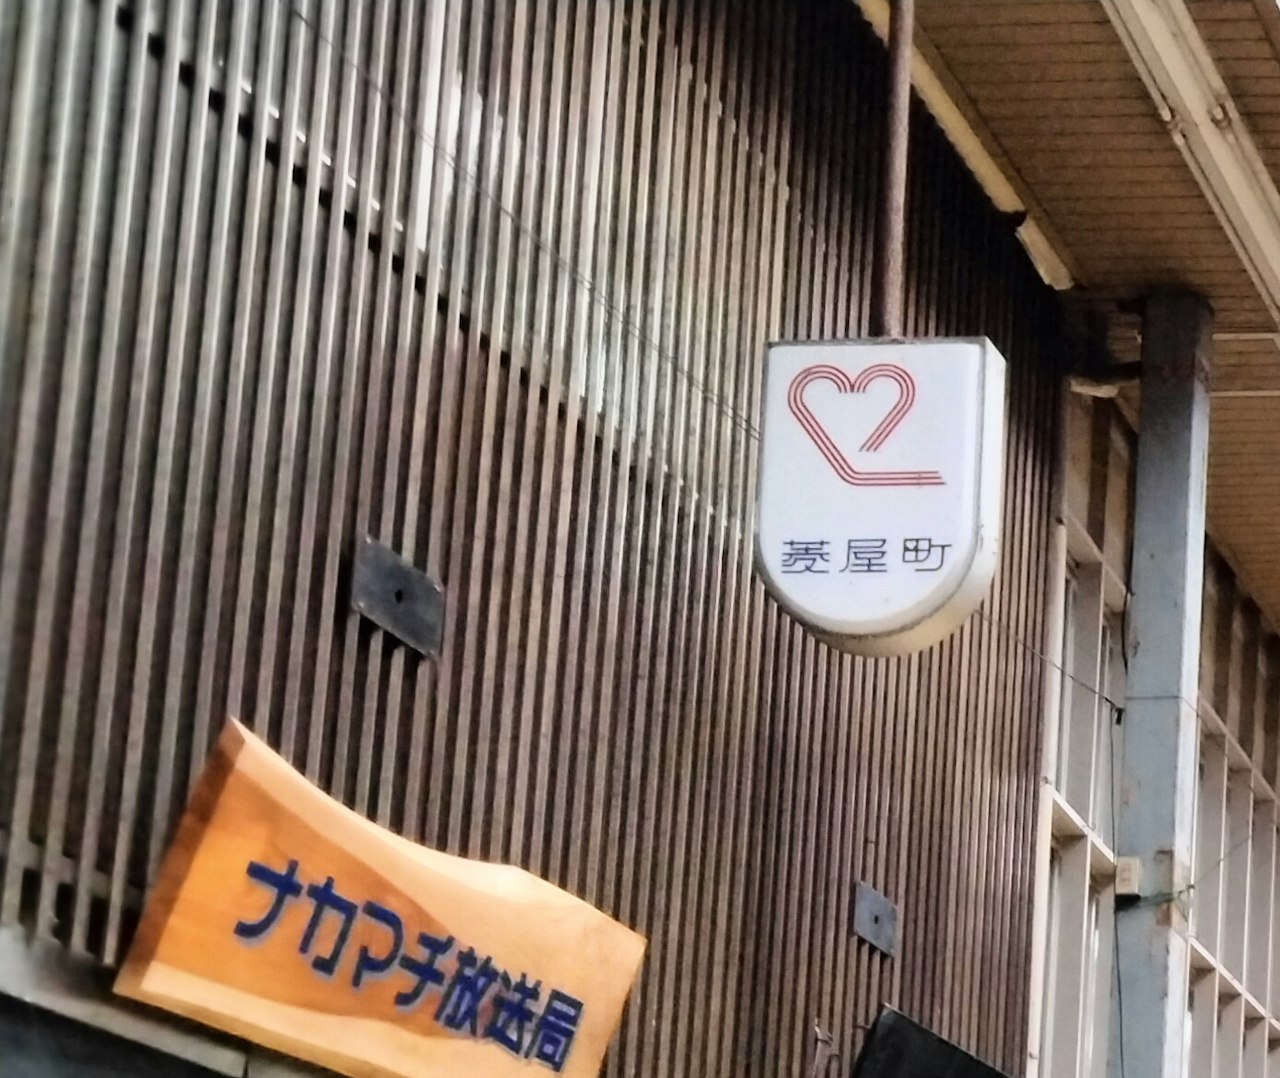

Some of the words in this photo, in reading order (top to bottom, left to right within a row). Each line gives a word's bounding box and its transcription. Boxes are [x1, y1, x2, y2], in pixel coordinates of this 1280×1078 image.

[780, 537, 953, 574] 菱屋町
[233, 858, 585, 1075] ナカマチ放送局
